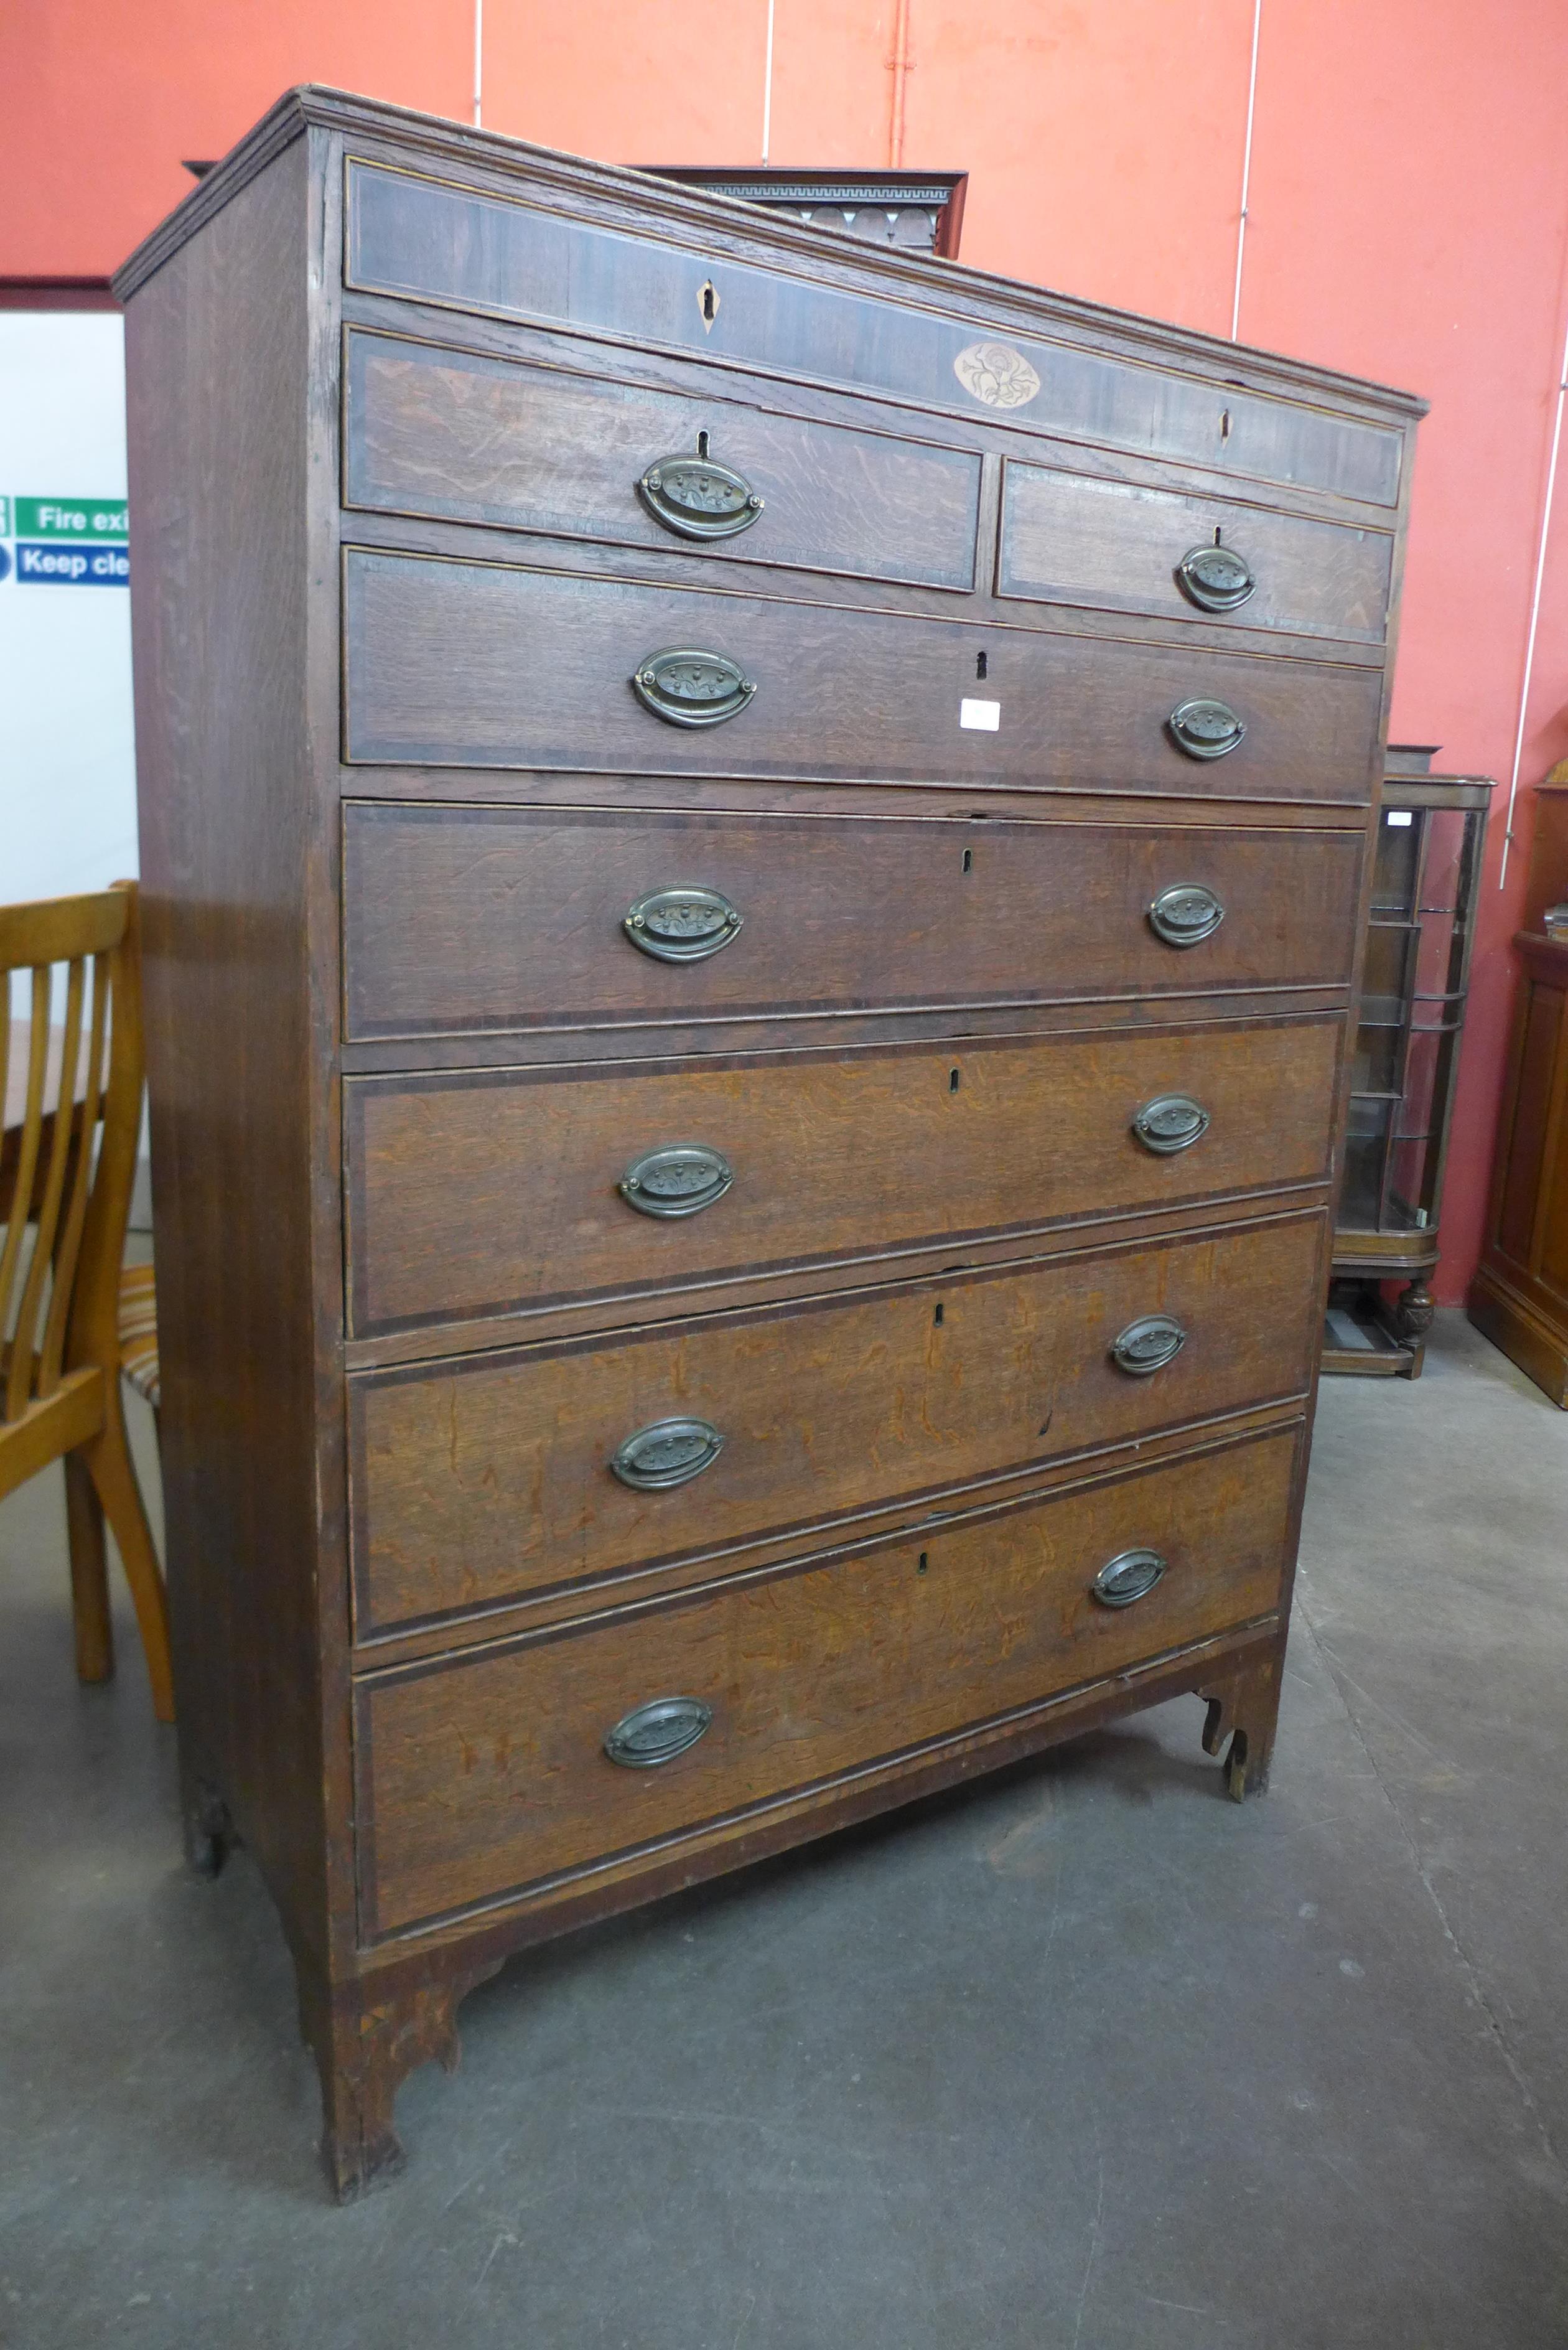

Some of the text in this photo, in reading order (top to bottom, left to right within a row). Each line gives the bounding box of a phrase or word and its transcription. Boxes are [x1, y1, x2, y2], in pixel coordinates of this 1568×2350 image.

[39, 507, 86, 530] Fire
[24, 550, 129, 579] Keep cle
